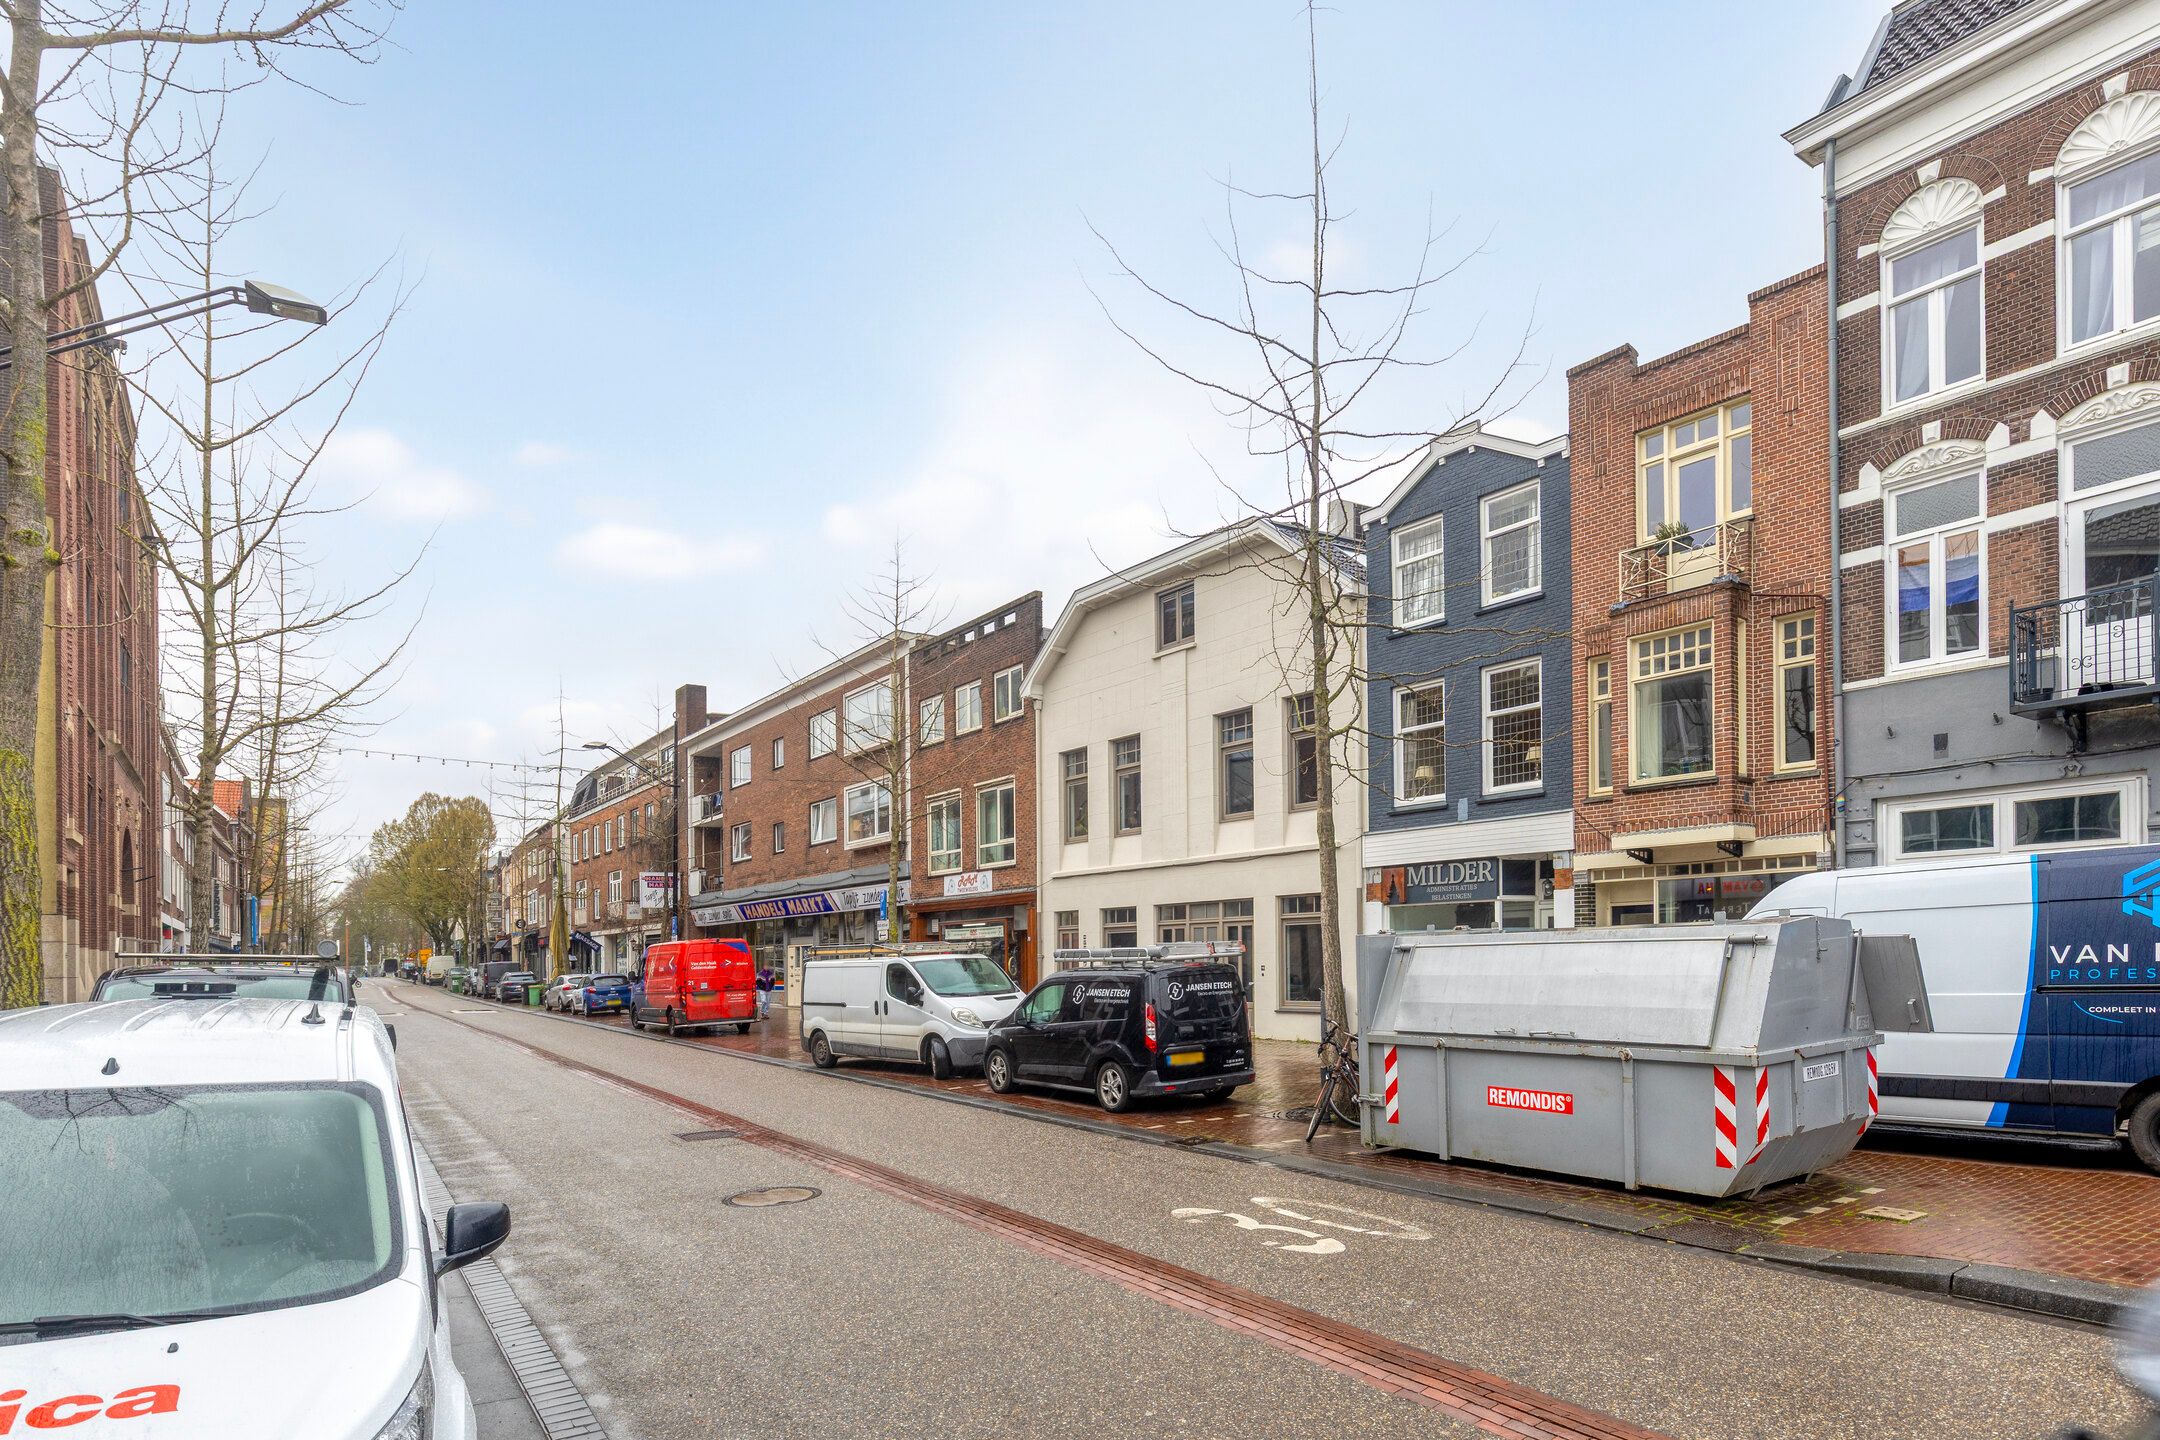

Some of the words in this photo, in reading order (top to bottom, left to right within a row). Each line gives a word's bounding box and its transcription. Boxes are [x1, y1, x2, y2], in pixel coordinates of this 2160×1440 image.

[1407, 860, 1494, 886] MILDER
[1427, 883, 1478, 893] ADMINISTRATIES
[1431, 892, 1472, 901] BELASTINGEN
[743, 901, 786, 919] HANDELS
[786, 896, 825, 914] MARKT
[575, 932, 599, 951] MASSAGE
[2049, 943, 2129, 964] VAN
[2050, 967, 2157, 980] PROFES
[1186, 982, 1213, 992] JANSEN
[1213, 981, 1232, 990] ETECH
[1086, 988, 1110, 997] JANSEN
[1110, 989, 1131, 998] ETECH
[2088, 1006, 2143, 1014] COMPLEET
